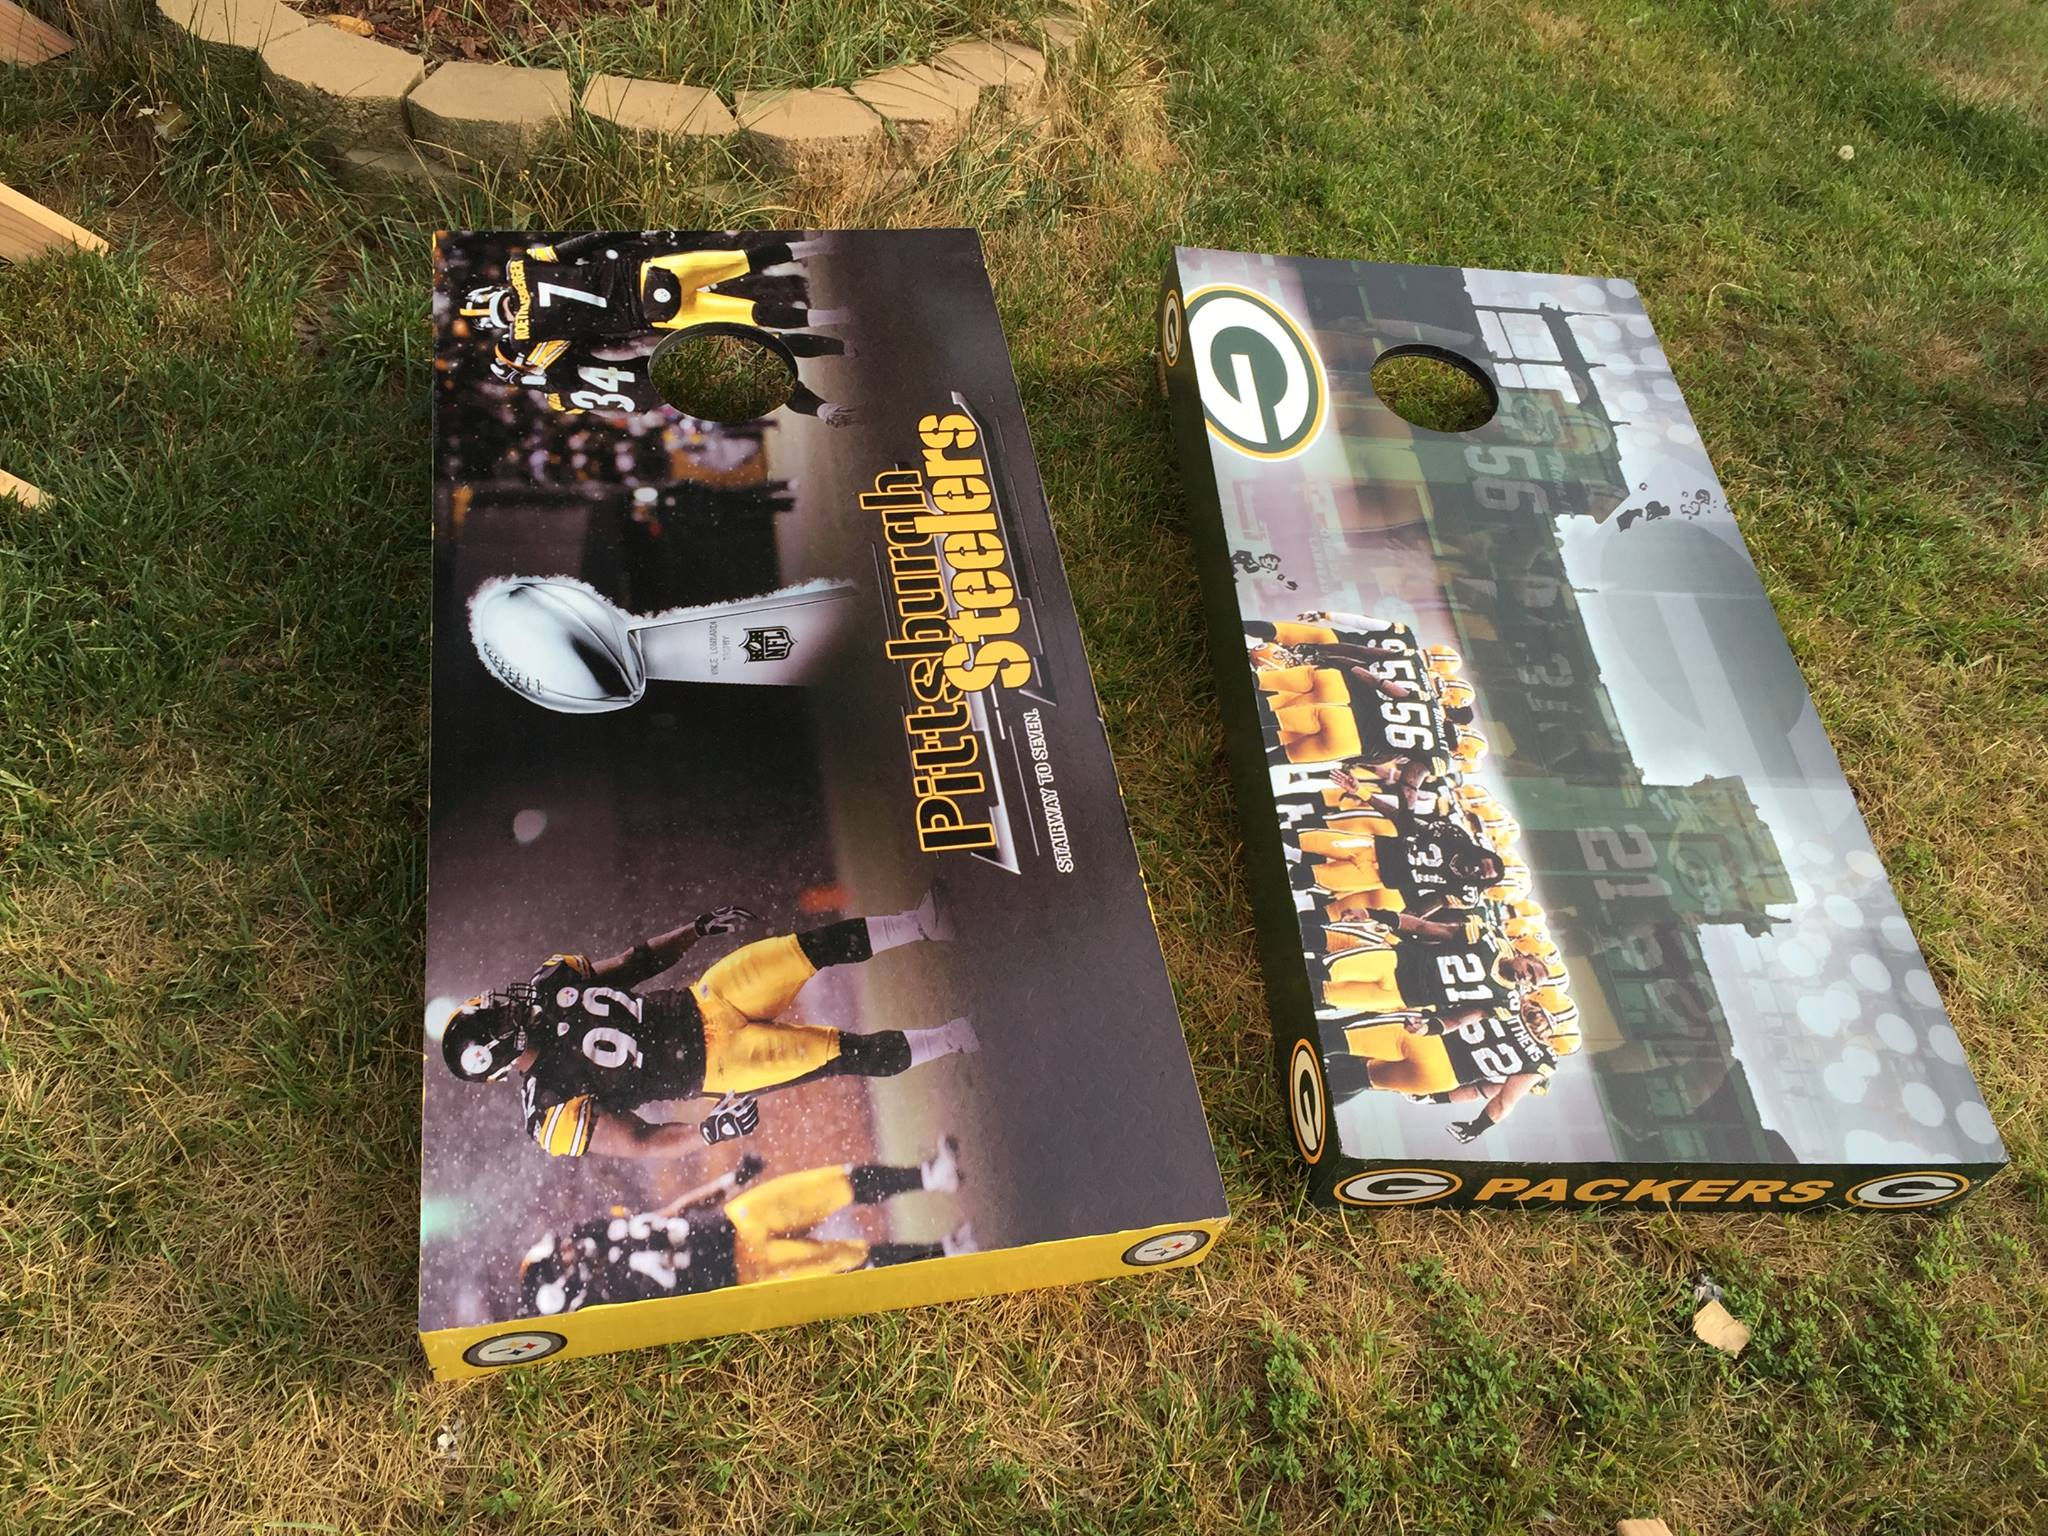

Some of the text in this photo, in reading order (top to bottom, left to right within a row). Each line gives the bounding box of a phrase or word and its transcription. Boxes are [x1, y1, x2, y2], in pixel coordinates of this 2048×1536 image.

[537, 281, 608, 308] 7
[569, 365, 636, 413] 34
[1188, 297, 1310, 444] G
[916, 413, 1033, 693] Steelers
[765, 630, 787, 660] NFL
[859, 469, 997, 854] Pittsburgh
[1379, 701, 1435, 751] 56
[1023, 708, 1074, 873] STAIRWAY TO SEVEN.
[1434, 952, 1493, 1003] 21
[582, 986, 644, 1069] 92
[1457, 1017, 1524, 1078] 52
[1294, 1050, 1322, 1151] G
[1345, 1172, 1450, 1203] G
[1473, 1178, 1834, 1206] PACKERS
[1857, 1173, 1958, 1206] G
